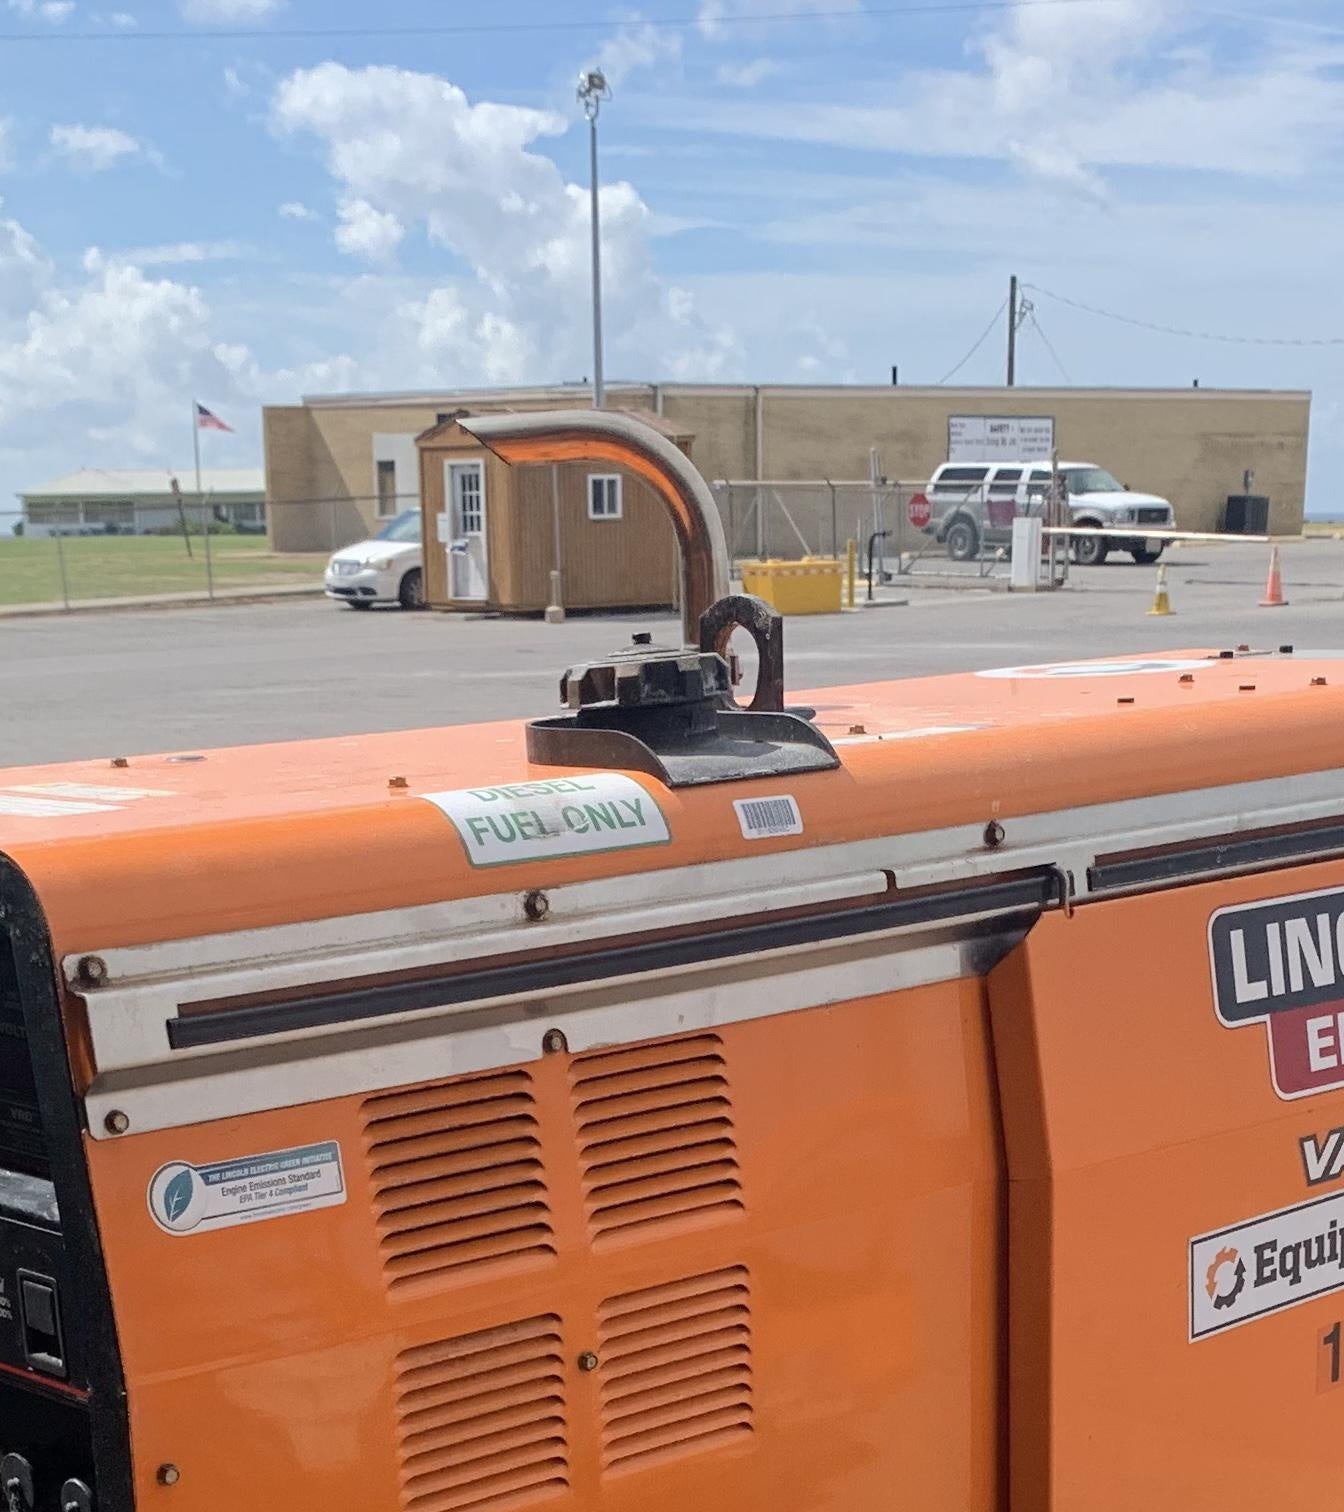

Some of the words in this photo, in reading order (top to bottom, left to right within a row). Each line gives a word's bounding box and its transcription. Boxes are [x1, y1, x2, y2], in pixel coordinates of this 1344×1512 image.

[467, 778, 596, 802] DIESEL
[465, 809, 560, 847] FUEL
[561, 797, 648, 835] ONLY
[221, 1184, 247, 1197] Engine
[249, 1176, 286, 1191] Emissions
[289, 1169, 321, 1184] Standard
